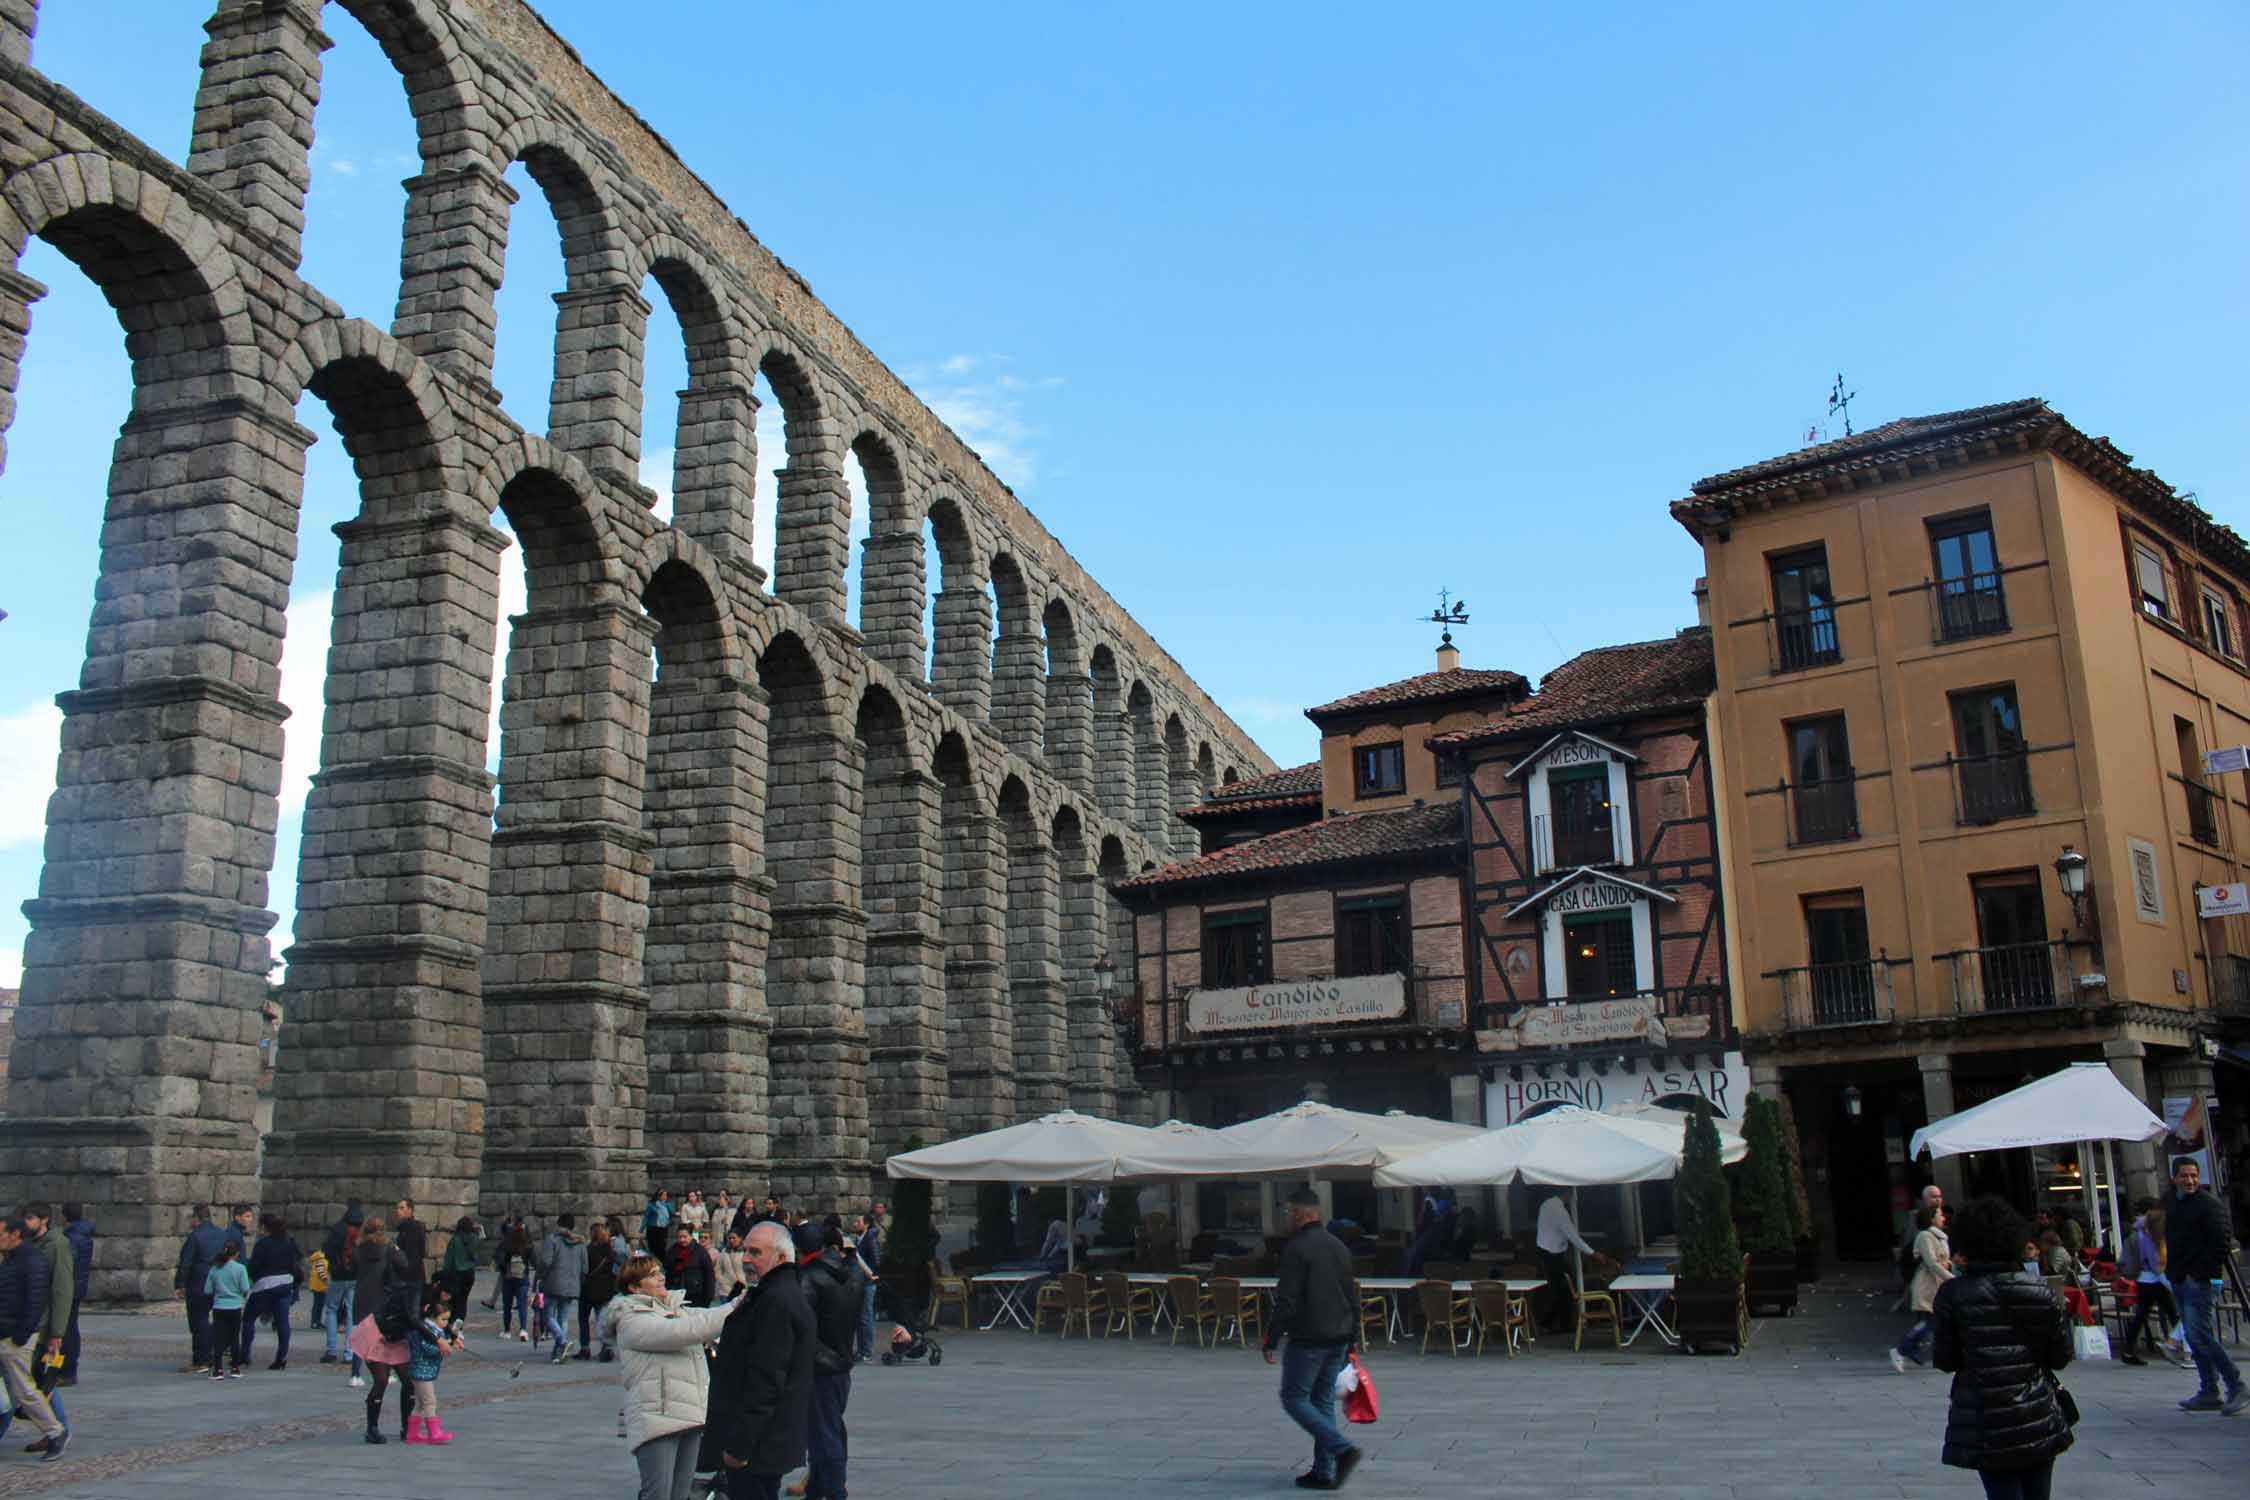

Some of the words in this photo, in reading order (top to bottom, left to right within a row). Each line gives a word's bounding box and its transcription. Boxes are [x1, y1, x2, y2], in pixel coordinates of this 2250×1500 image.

[1550, 744, 1601, 766] MESON
[1551, 889, 1580, 912] CASA
[1583, 887, 1637, 909] CANDIDO
[1247, 981, 1340, 1008] Candido
[1269, 1006, 1310, 1021] Mayor
[1316, 1007, 1330, 1017] de
[1336, 999, 1384, 1015] Castilla
[1504, 1079, 1603, 1125] HORNO
[1641, 1071, 1731, 1116] ASAR
